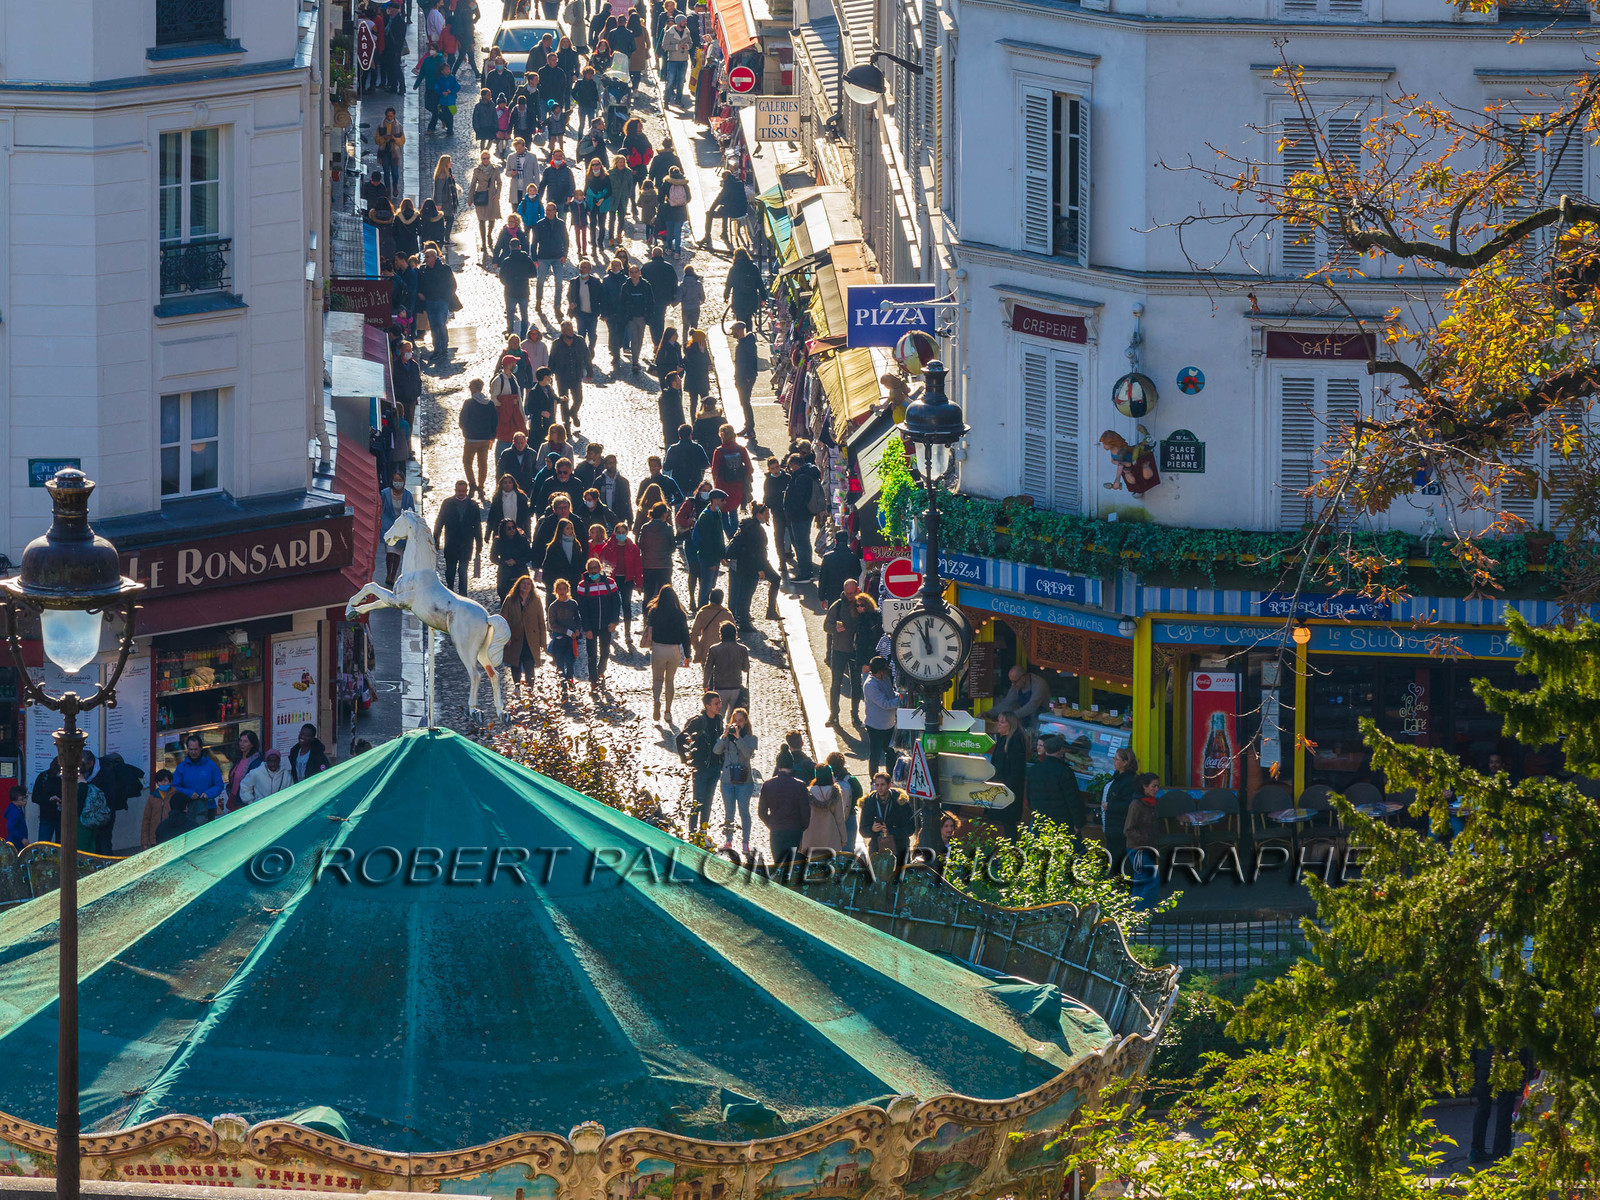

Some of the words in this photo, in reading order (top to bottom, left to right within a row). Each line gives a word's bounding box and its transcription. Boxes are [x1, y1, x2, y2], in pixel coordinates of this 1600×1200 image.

[360, 26, 369, 66] TABAC
[758, 101, 799, 112] GALERIES
[768, 114, 789, 125] DES
[759, 127, 798, 138] TISSUS
[855, 307, 928, 326] PIZZA
[1022, 317, 1077, 339] CREPERIE
[1302, 341, 1342, 356] CAFE
[1167, 461, 1198, 469] PIERRE
[1170, 453, 1195, 461] SAINT
[1424, 484, 1439, 495] 15
[128, 557, 165, 589] LE
[177, 528, 333, 586] RONSARD
[1036, 579, 1075, 597] CREPE
[991, 597, 1027, 617] Crêpes
[1032, 606, 1042, 619] &
[1047, 609, 1104, 633] Sandwichs
[1349, 628, 1418, 650] Studio
[948, 738, 981, 749] toilettes
[123, 1164, 242, 1178] CARROUSEL
[254, 1167, 363, 1190] VENITIEN
